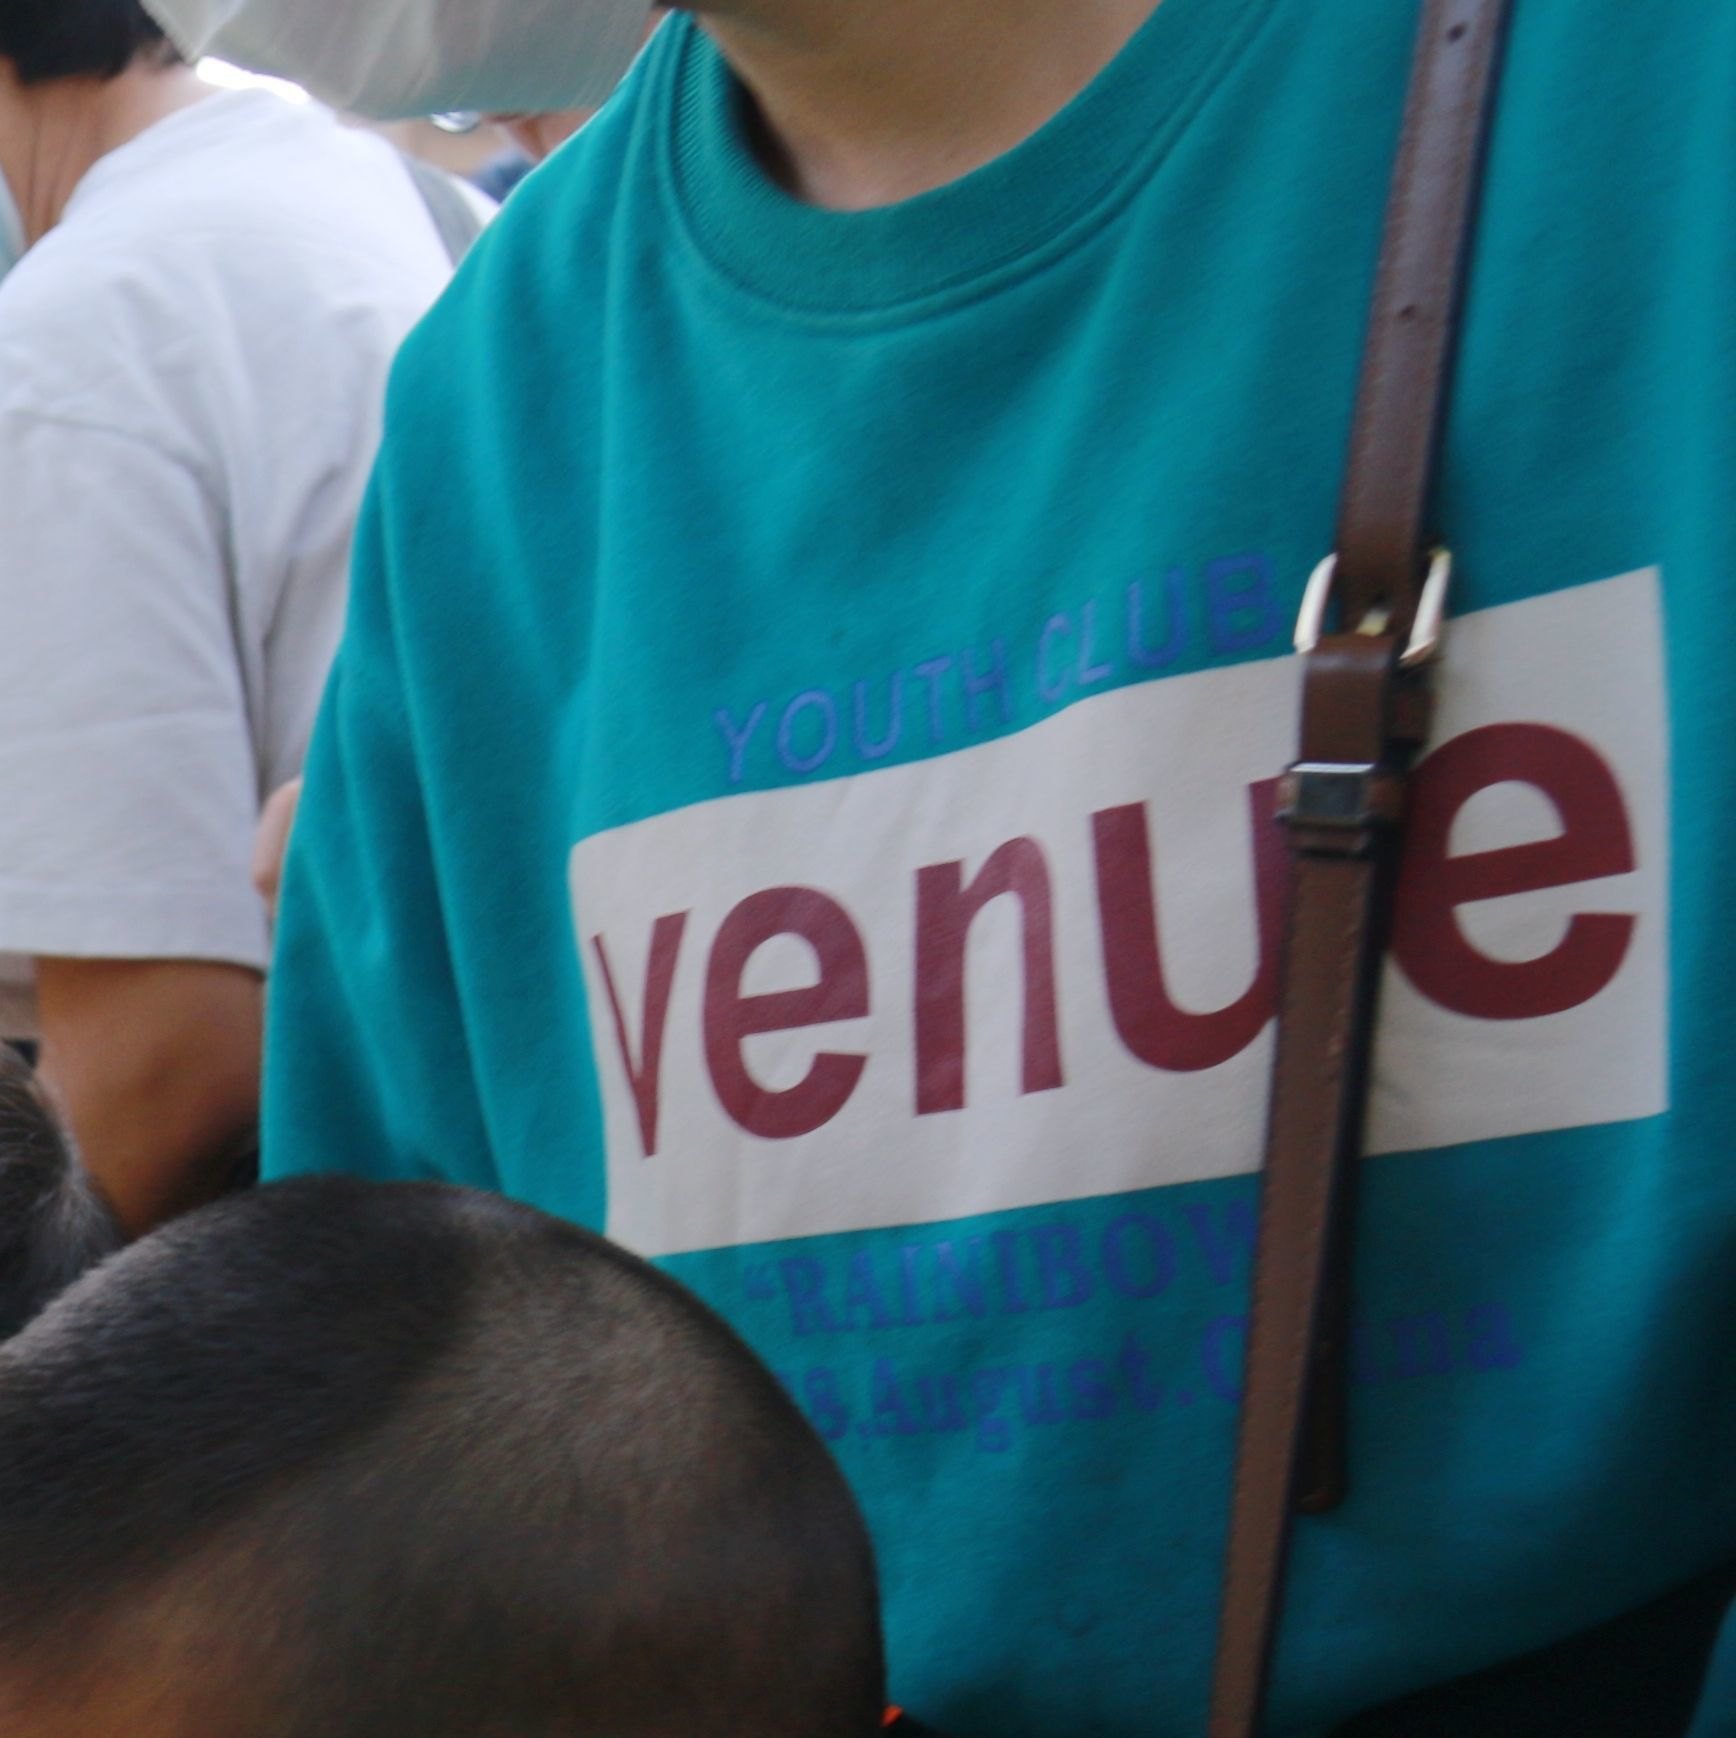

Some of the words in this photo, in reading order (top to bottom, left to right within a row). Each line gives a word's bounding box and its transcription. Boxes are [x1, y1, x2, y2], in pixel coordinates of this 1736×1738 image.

[711, 637, 1015, 785] YOUTH
[1034, 550, 1285, 705] CLUB
[591, 721, 1636, 1159] venue
